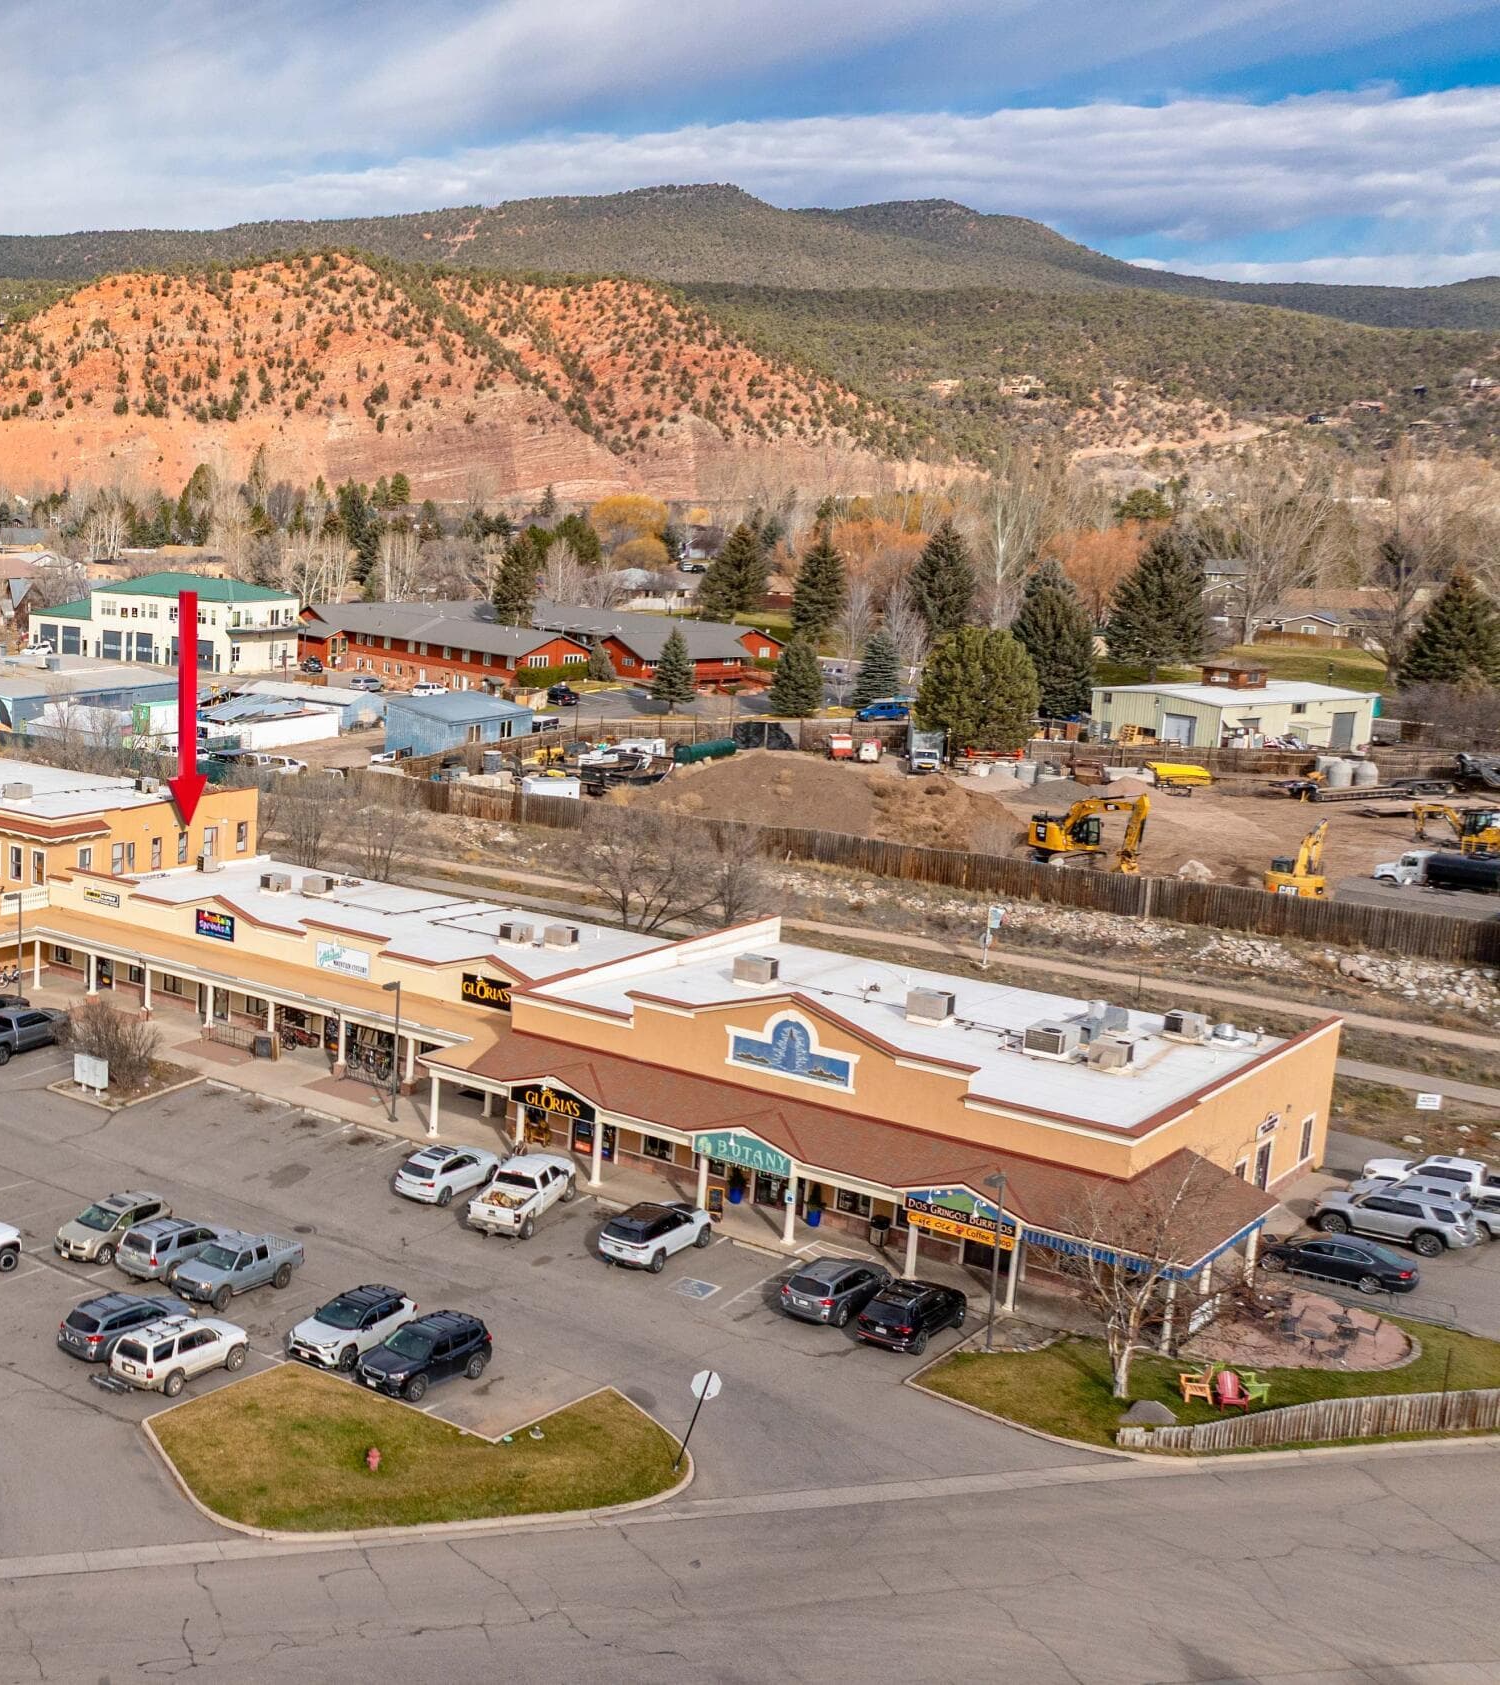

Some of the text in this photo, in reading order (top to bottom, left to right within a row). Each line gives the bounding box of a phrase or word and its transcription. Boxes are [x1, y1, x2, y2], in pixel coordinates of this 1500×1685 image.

[462, 981, 510, 1003] GLORIA'S
[525, 1090, 580, 1117] GLORIA'S
[717, 1140, 789, 1170] BOTANY
[908, 1198, 1013, 1234] DOS GRINGOS BURRIOS
[993, 1236, 1011, 1248] Sop
